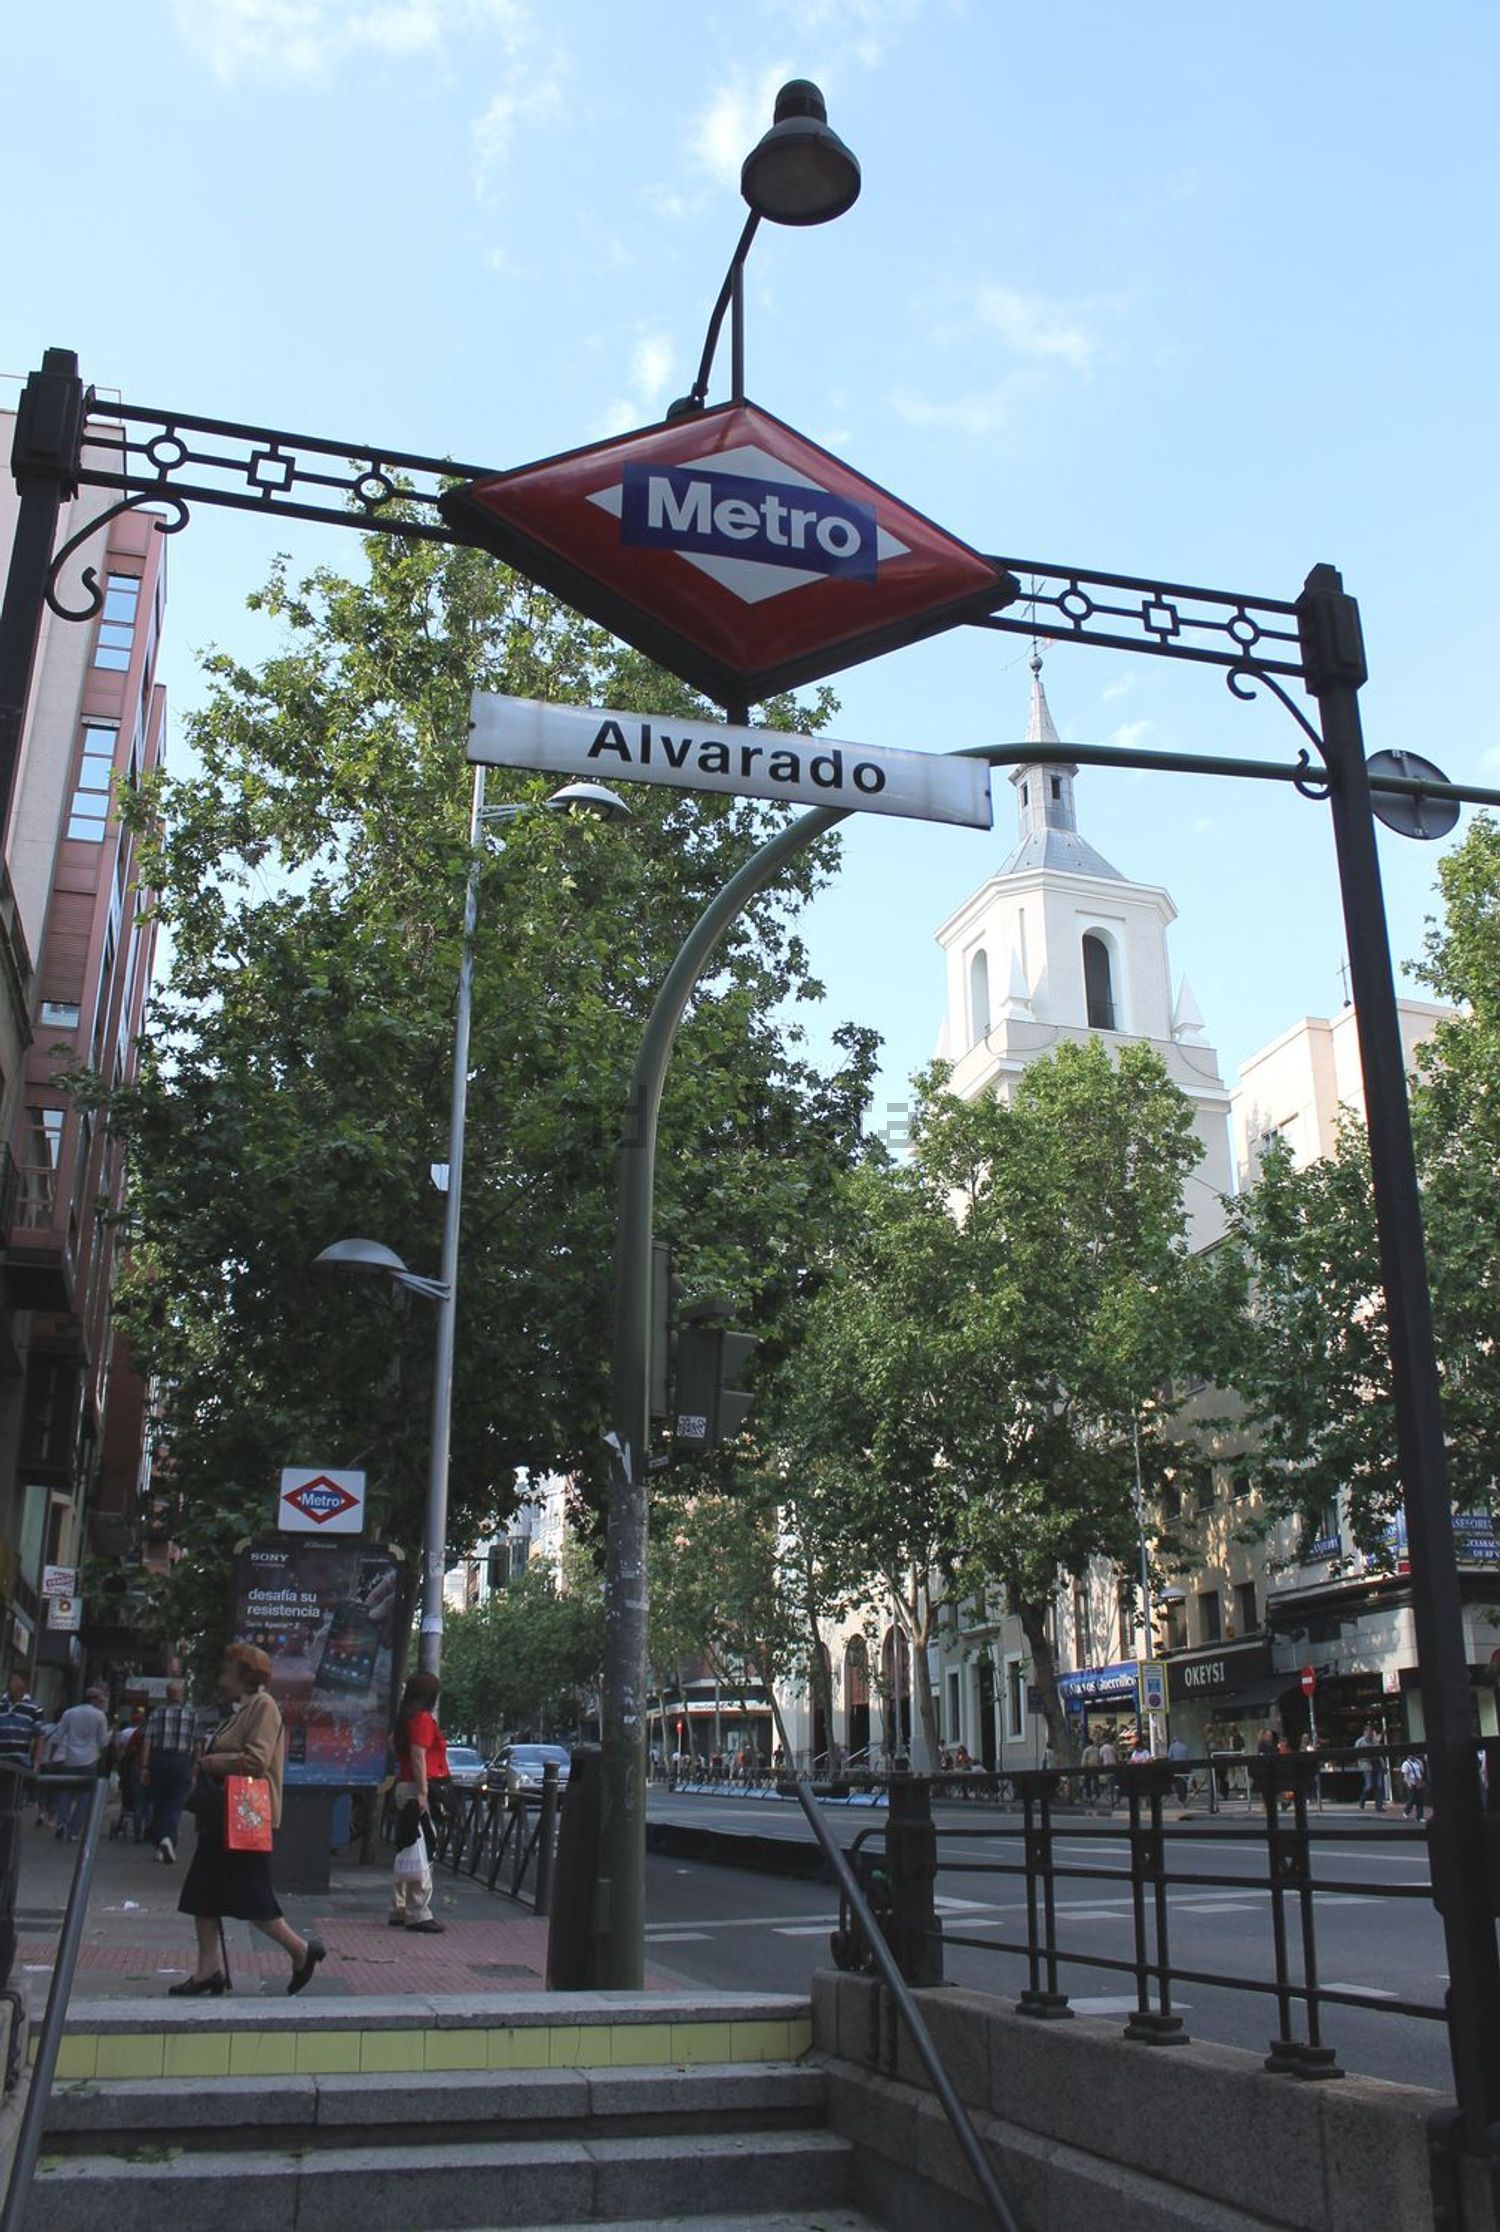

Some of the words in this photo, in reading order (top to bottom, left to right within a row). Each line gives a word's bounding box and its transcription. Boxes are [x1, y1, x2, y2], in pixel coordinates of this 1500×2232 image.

[648, 476, 861, 557] Metro
[587, 719, 887, 794] Alvarado
[301, 1493, 340, 1507] Metro
[250, 1553, 289, 1562] SONY
[248, 1589, 297, 1601] desafía
[300, 1593, 317, 1603] su
[247, 1603, 320, 1617] resistencia
[1184, 1661, 1225, 1687] OKEYSI
